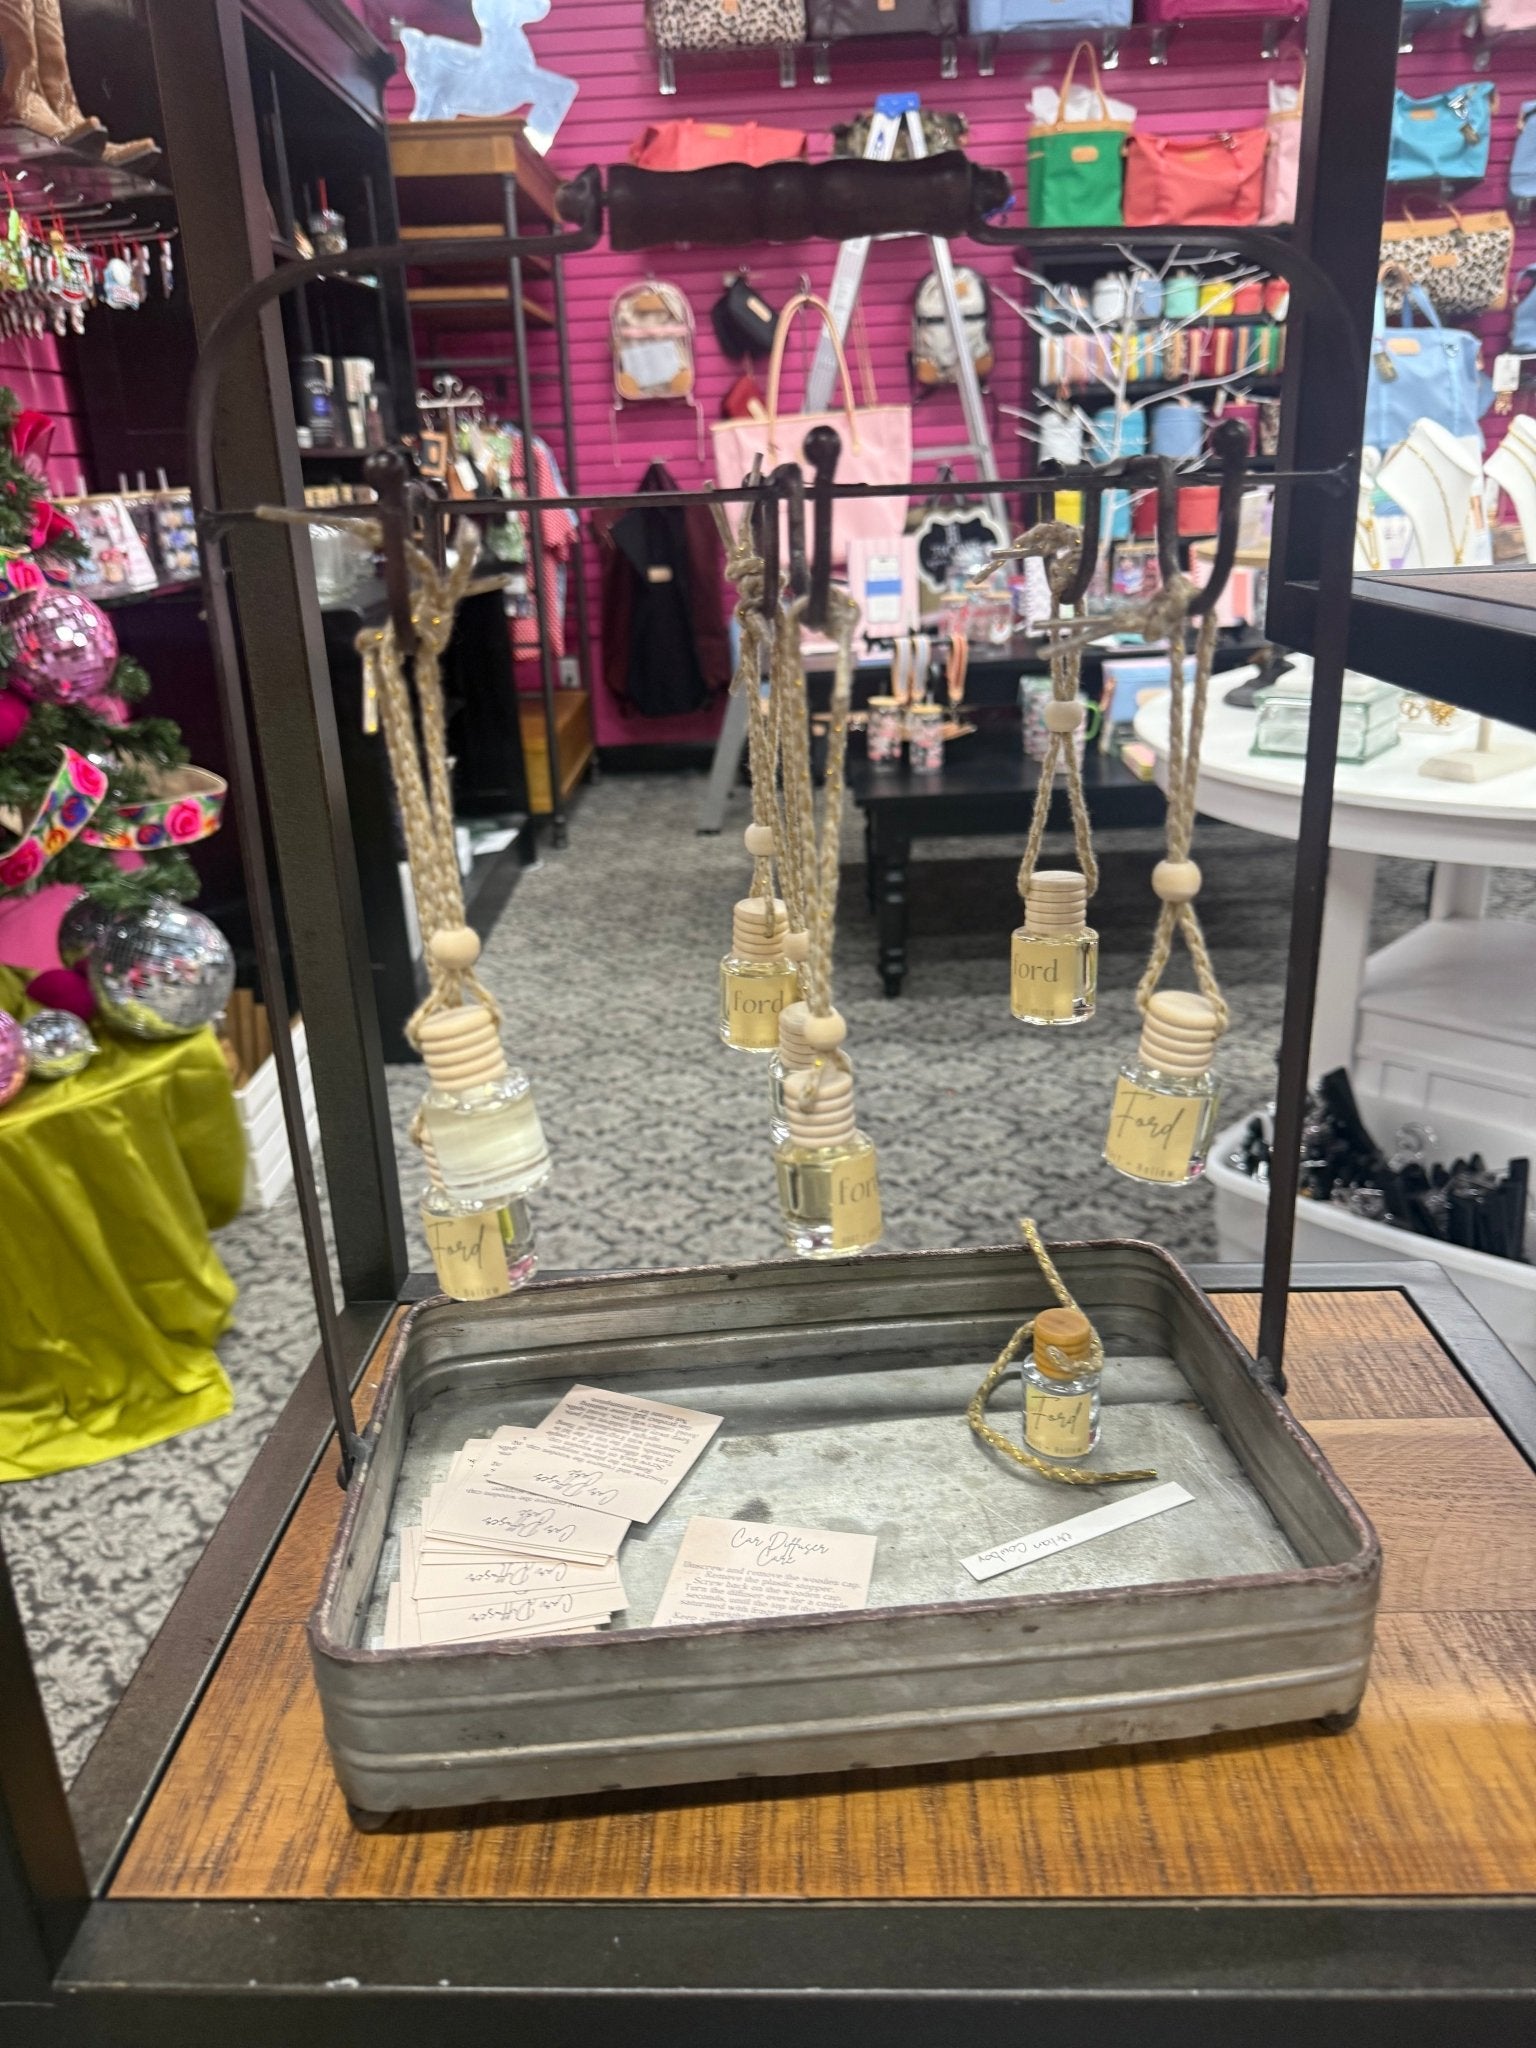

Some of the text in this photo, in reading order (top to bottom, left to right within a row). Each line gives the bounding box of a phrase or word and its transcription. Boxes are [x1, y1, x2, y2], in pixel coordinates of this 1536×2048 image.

[732, 990, 784, 1014] ford
[1115, 1090, 1185, 1150] Ford
[427, 1220, 485, 1270] Ford
[1031, 1396, 1083, 1434] Ford
[731, 1527, 830, 1556] Car Diffuser
